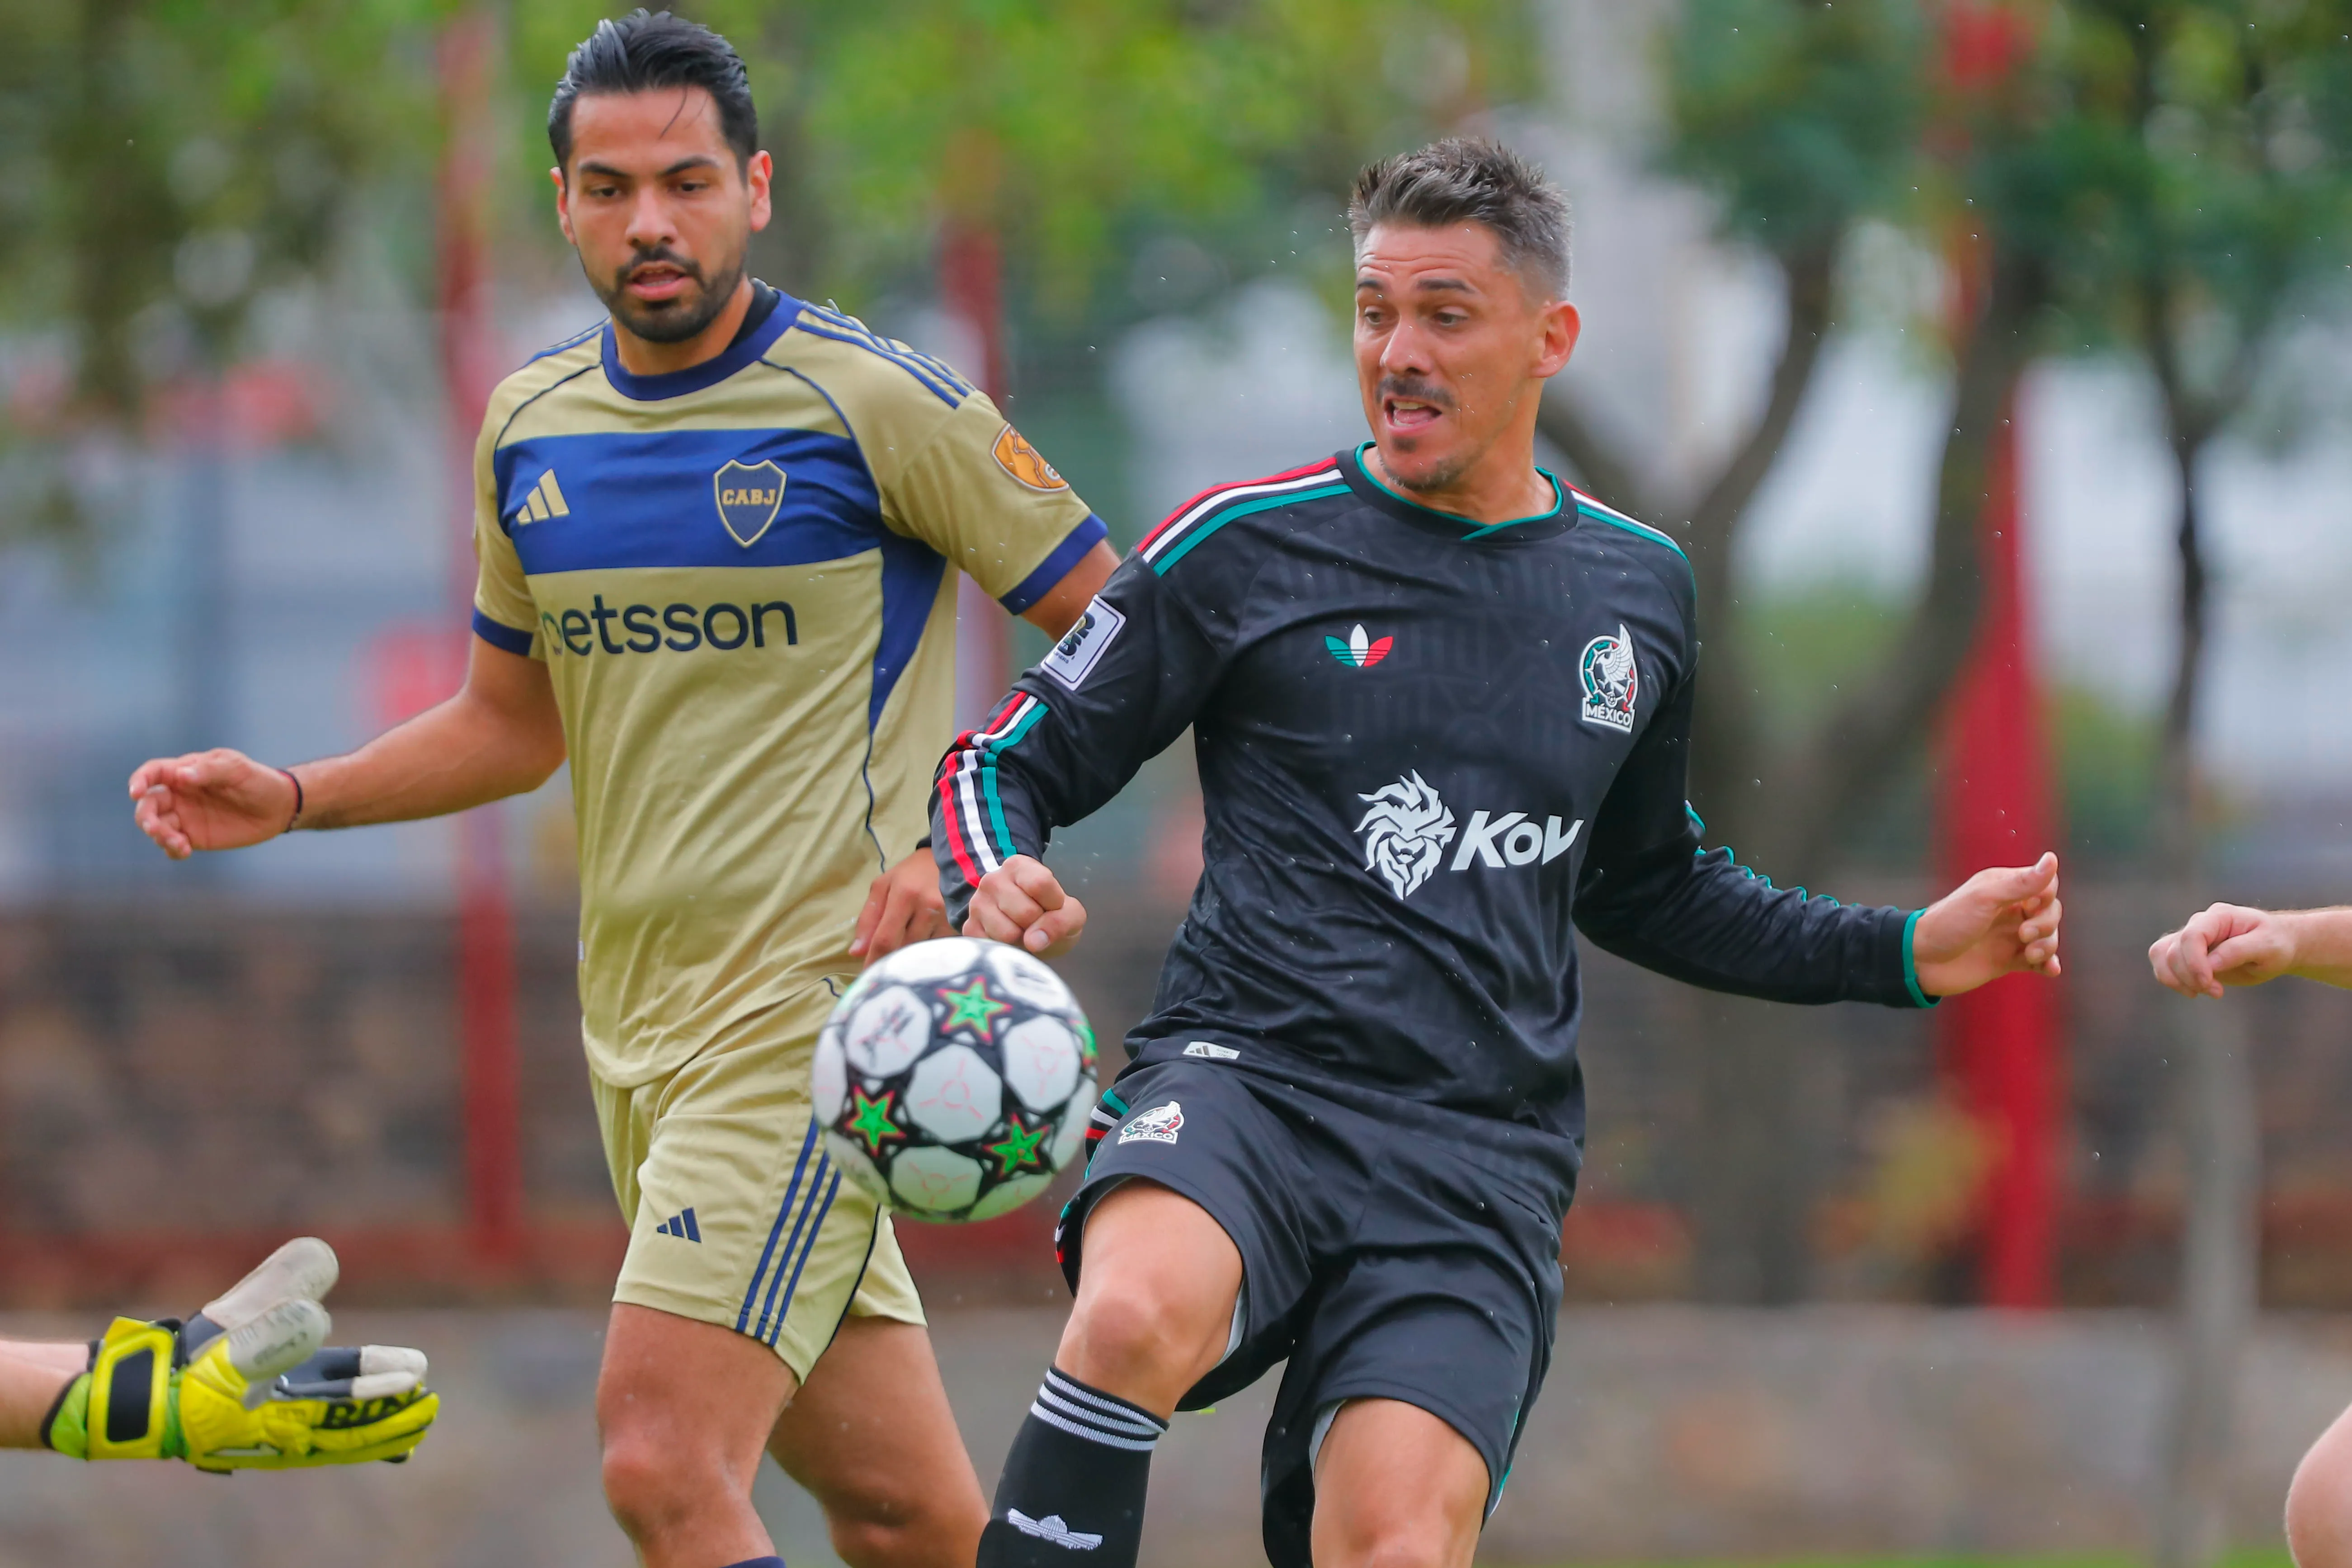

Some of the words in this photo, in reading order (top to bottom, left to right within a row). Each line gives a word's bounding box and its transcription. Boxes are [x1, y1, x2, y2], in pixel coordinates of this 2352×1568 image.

[723, 488, 776, 505] CABJ
[1586, 703, 1631, 725] MÉXICO
[1122, 1132, 1174, 1141] MÉXICO
